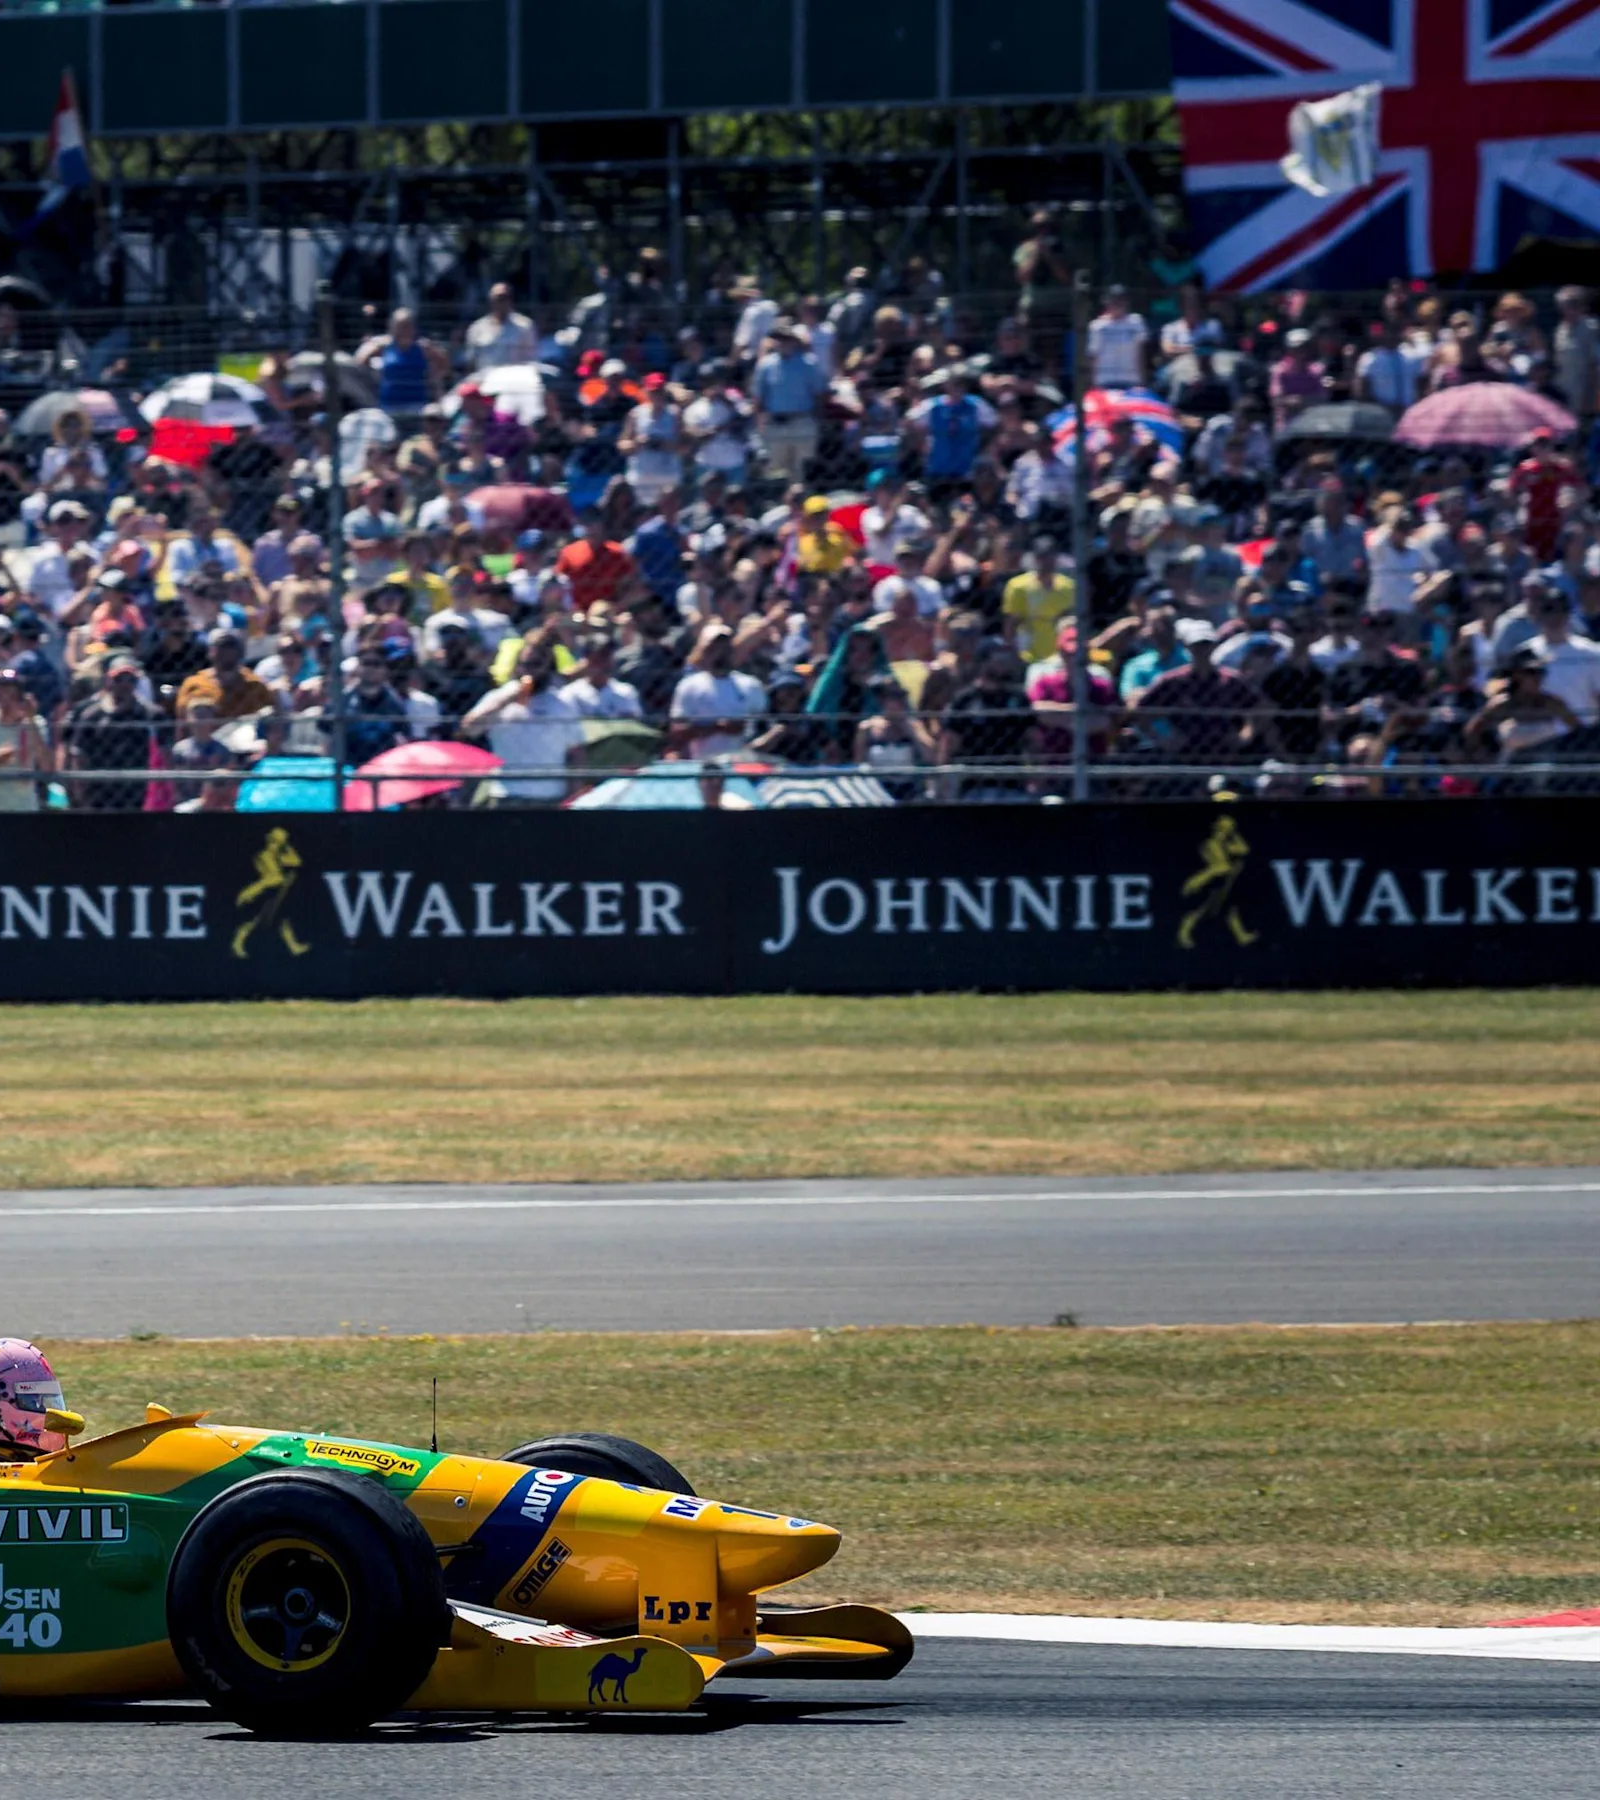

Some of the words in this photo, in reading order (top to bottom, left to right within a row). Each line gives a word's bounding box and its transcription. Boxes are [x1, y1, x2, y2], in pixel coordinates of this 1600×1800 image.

[323, 871, 685, 938] WALKER
[762, 867, 1152, 953] JOHNNIE
[1270, 859, 1600, 926] WALKE
[312, 1442, 416, 1471] TECHNOGYM
[644, 1596, 712, 1624] Lpr
